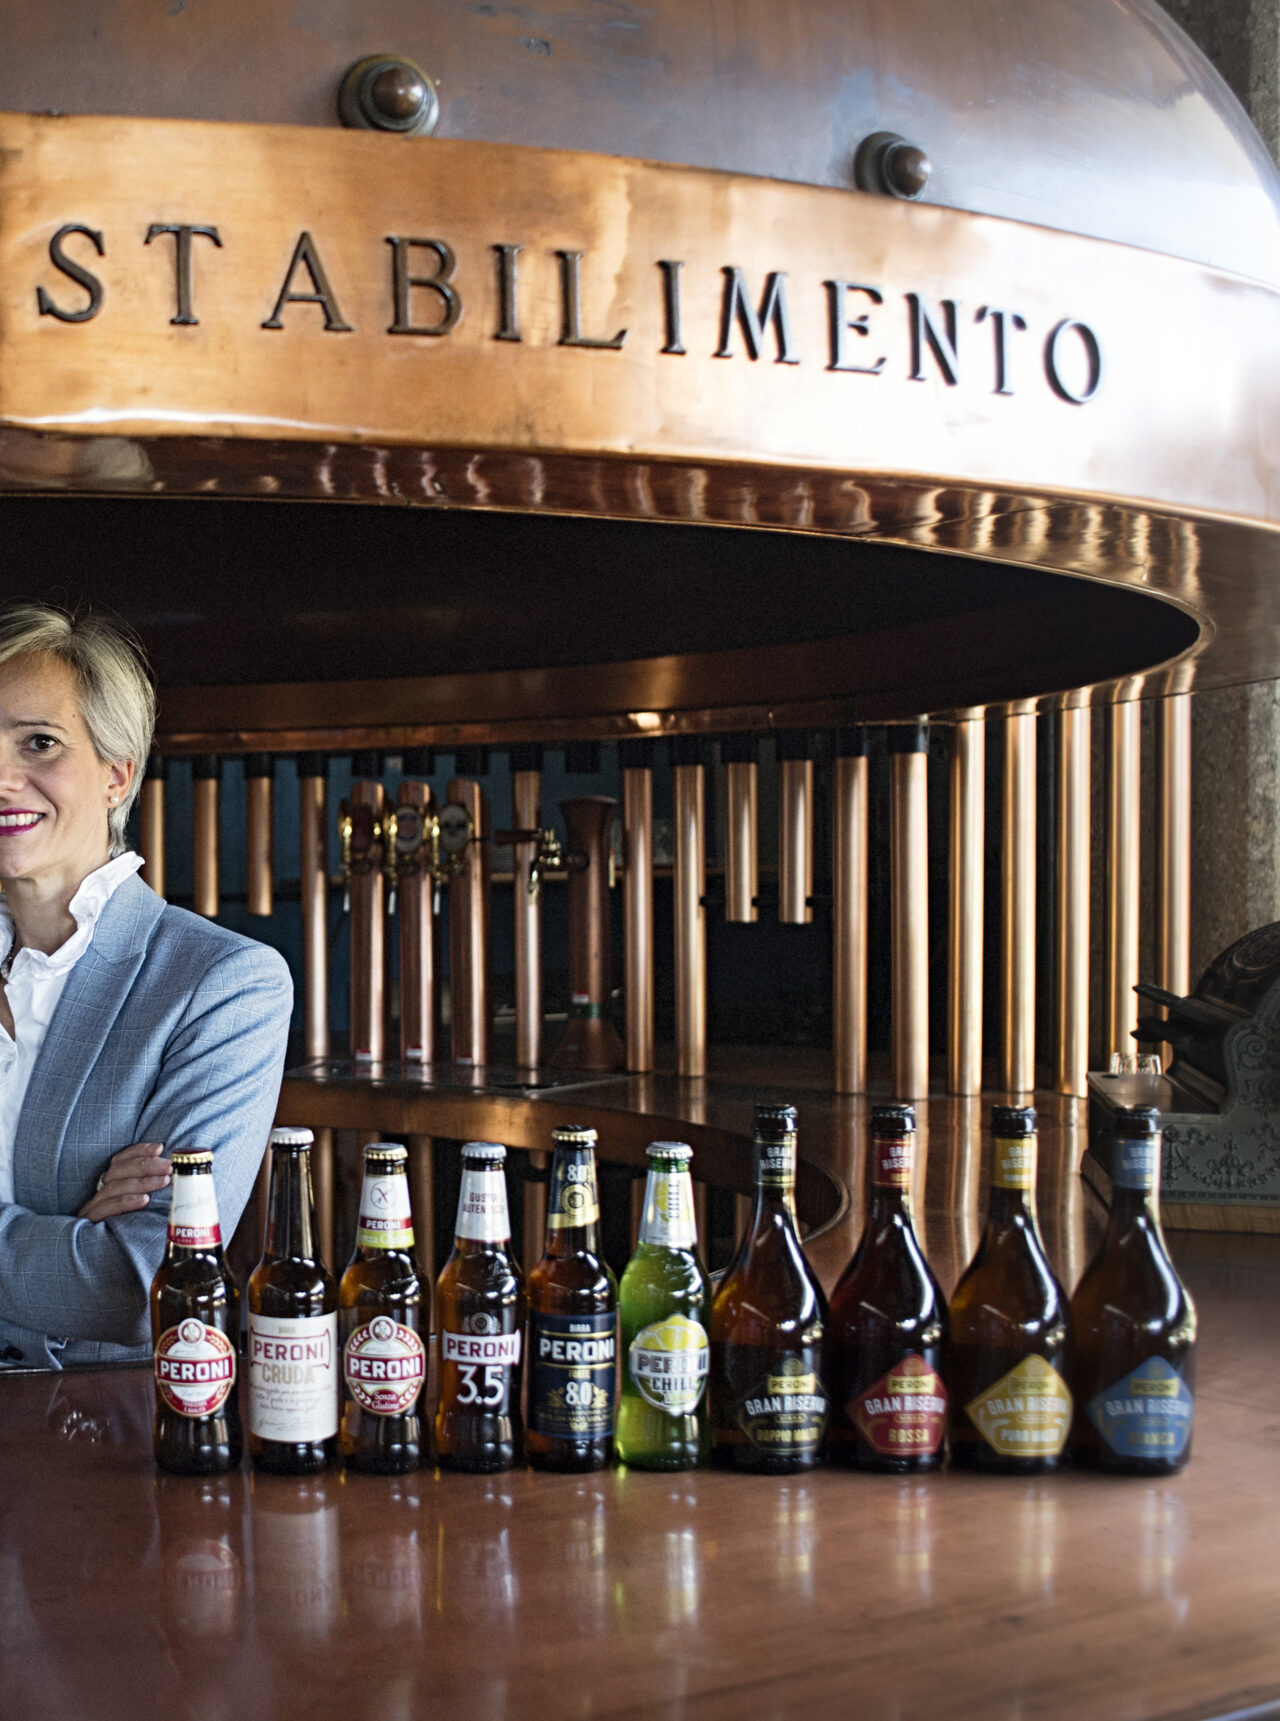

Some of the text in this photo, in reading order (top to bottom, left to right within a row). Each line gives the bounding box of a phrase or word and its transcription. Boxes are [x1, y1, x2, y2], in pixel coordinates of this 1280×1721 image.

[37, 223, 1104, 406] STABILIMENTO
[462, 1203, 504, 1214] AUTENCO
[176, 1227, 210, 1238] PERONI
[366, 1218, 401, 1230] PERONI
[254, 1339, 325, 1361] PERONI
[447, 1337, 515, 1358] PERONI
[539, 1337, 615, 1361] PERONI
[160, 1358, 230, 1381] PERONI
[261, 1361, 315, 1385] CRUDA
[349, 1356, 420, 1379] PERONI
[456, 1364, 504, 1406] 3.5
[652, 1376, 696, 1391] CHILL
[374, 1390, 397, 1400] Senza
[745, 1396, 781, 1416] GRAN
[864, 1396, 902, 1415] GRAN
[986, 1397, 1024, 1415] GRAN
[888, 1429, 930, 1443] ROSSA
